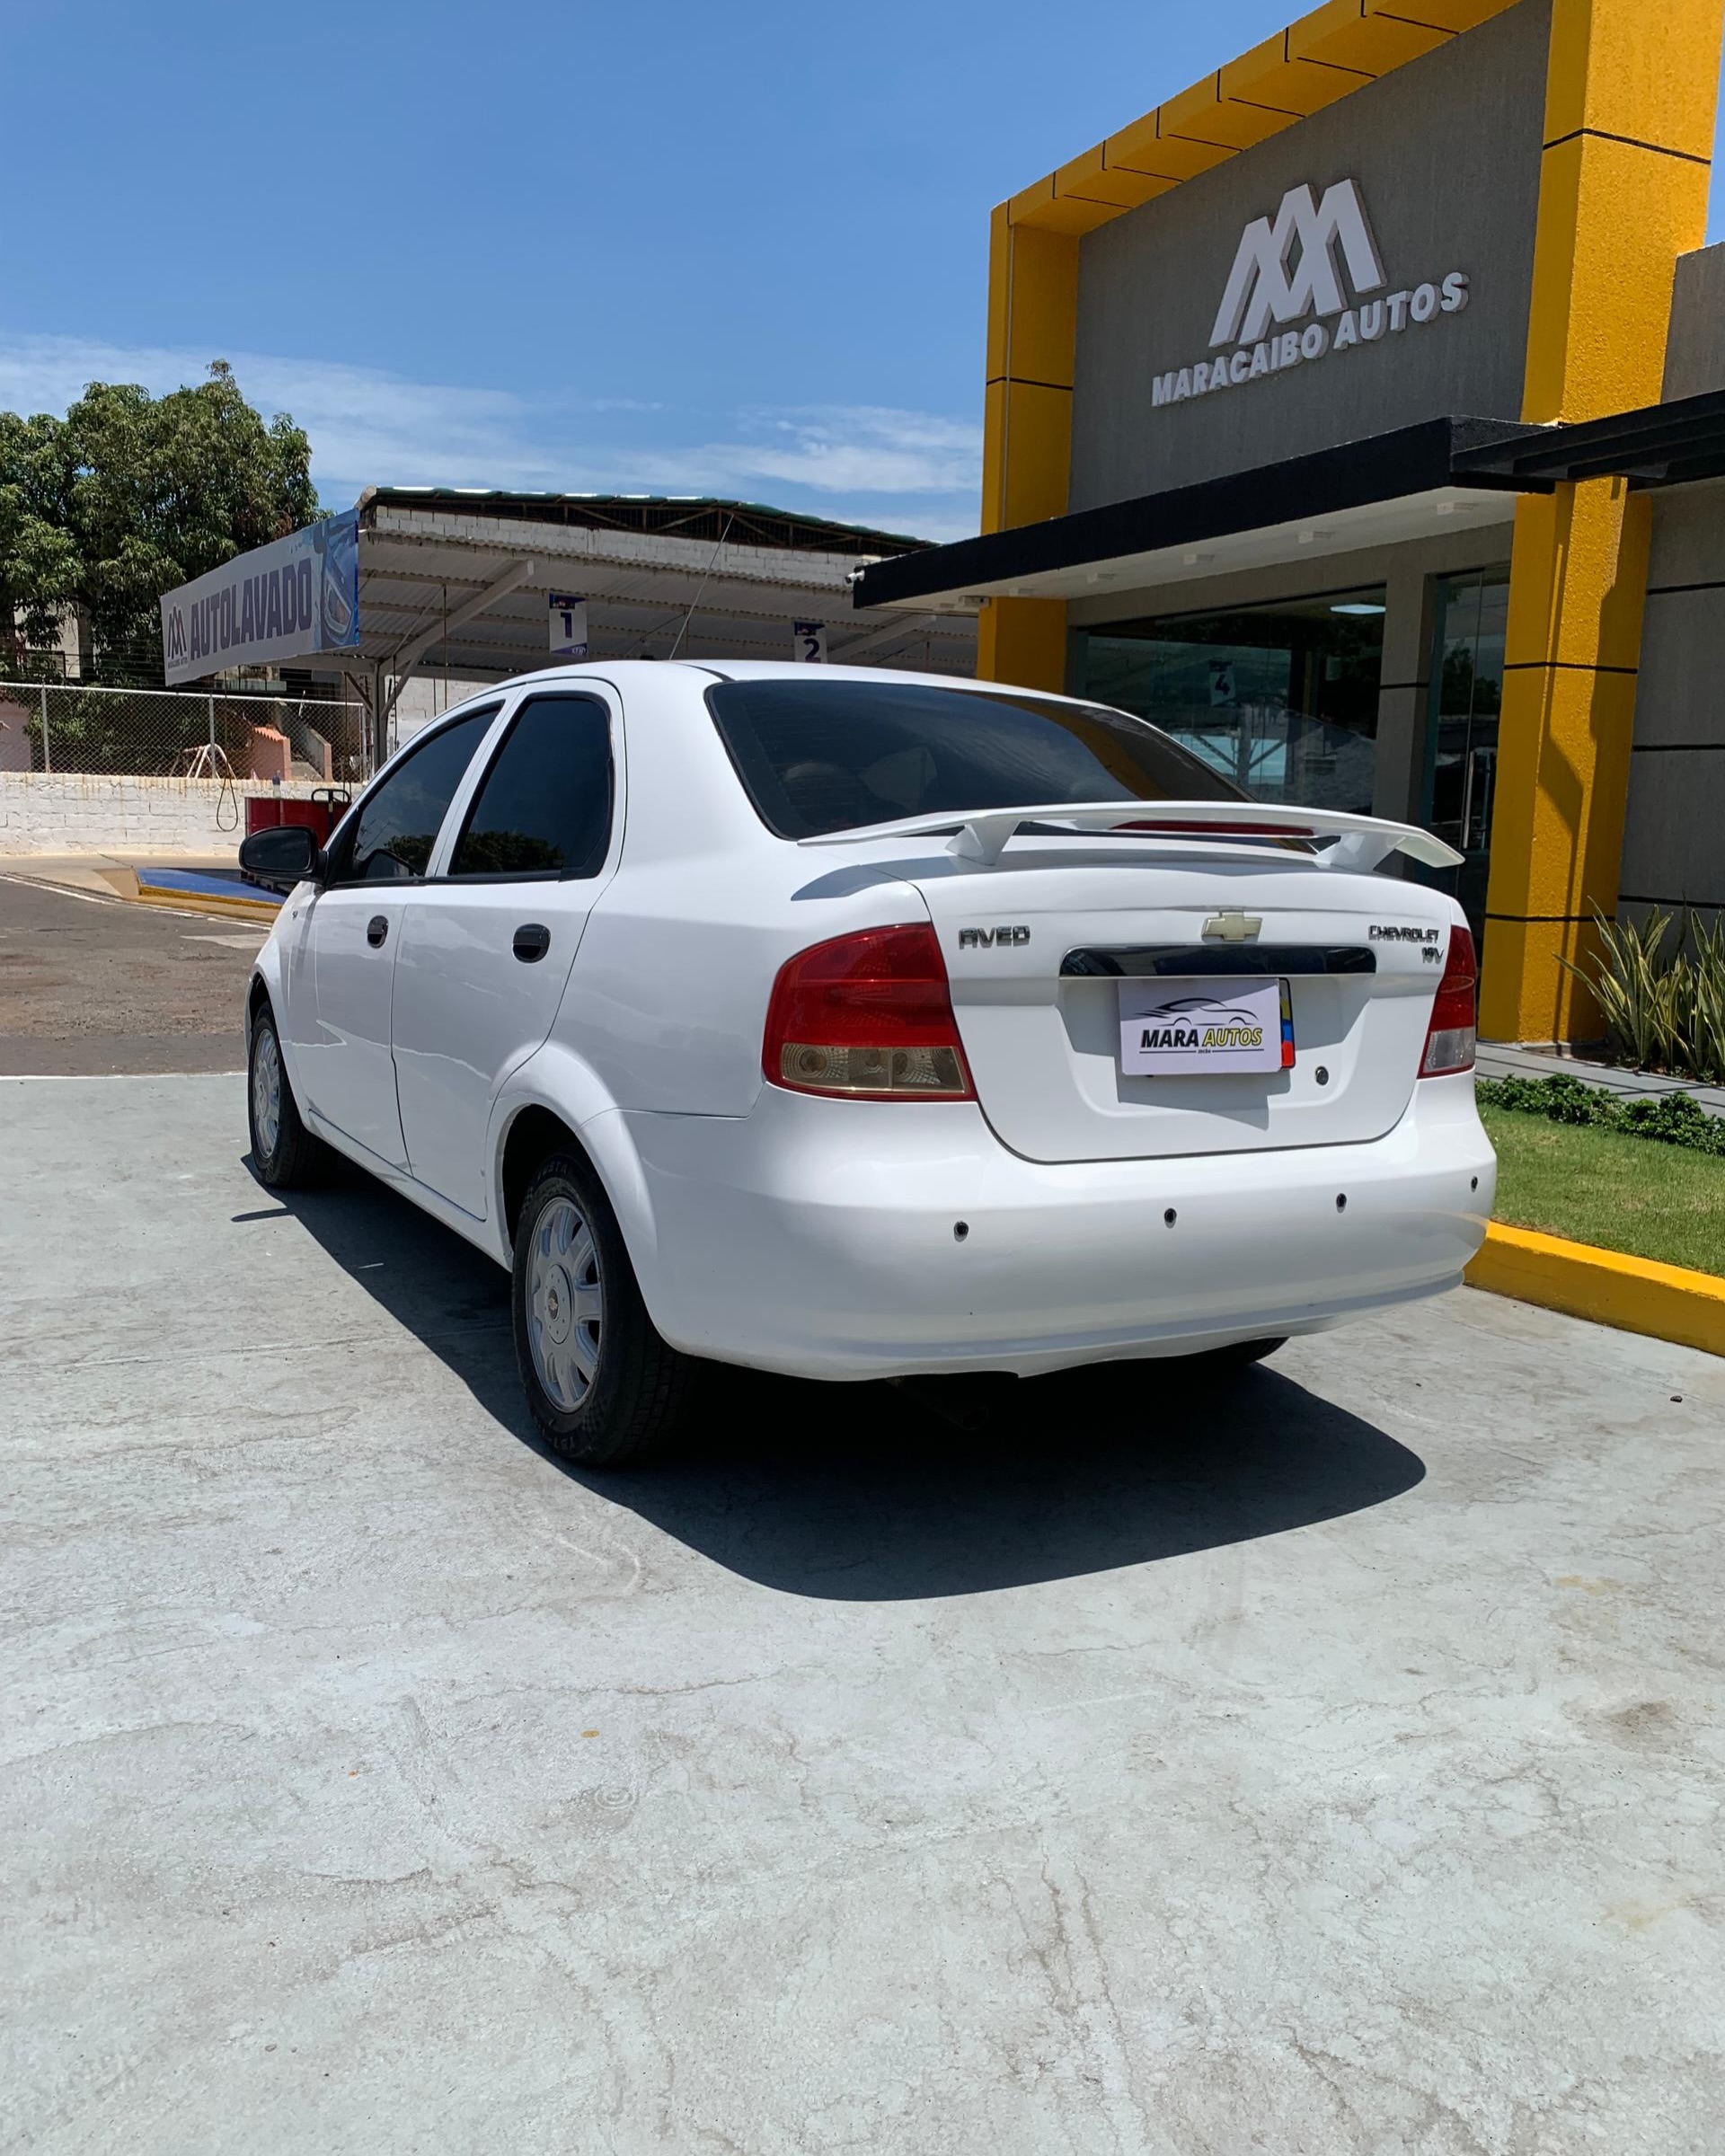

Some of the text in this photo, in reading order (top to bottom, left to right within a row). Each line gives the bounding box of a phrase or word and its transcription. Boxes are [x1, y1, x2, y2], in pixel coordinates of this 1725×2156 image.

[1151, 271, 1470, 407] MARACAIBO AUTOS
[190, 557, 313, 661] AUTOLAVADO
[560, 612, 572, 639] 1
[803, 638, 821, 663] 2
[1368, 925, 1439, 943] CHEVROLET
[1141, 1028, 1262, 1047] MARA AUTOS
